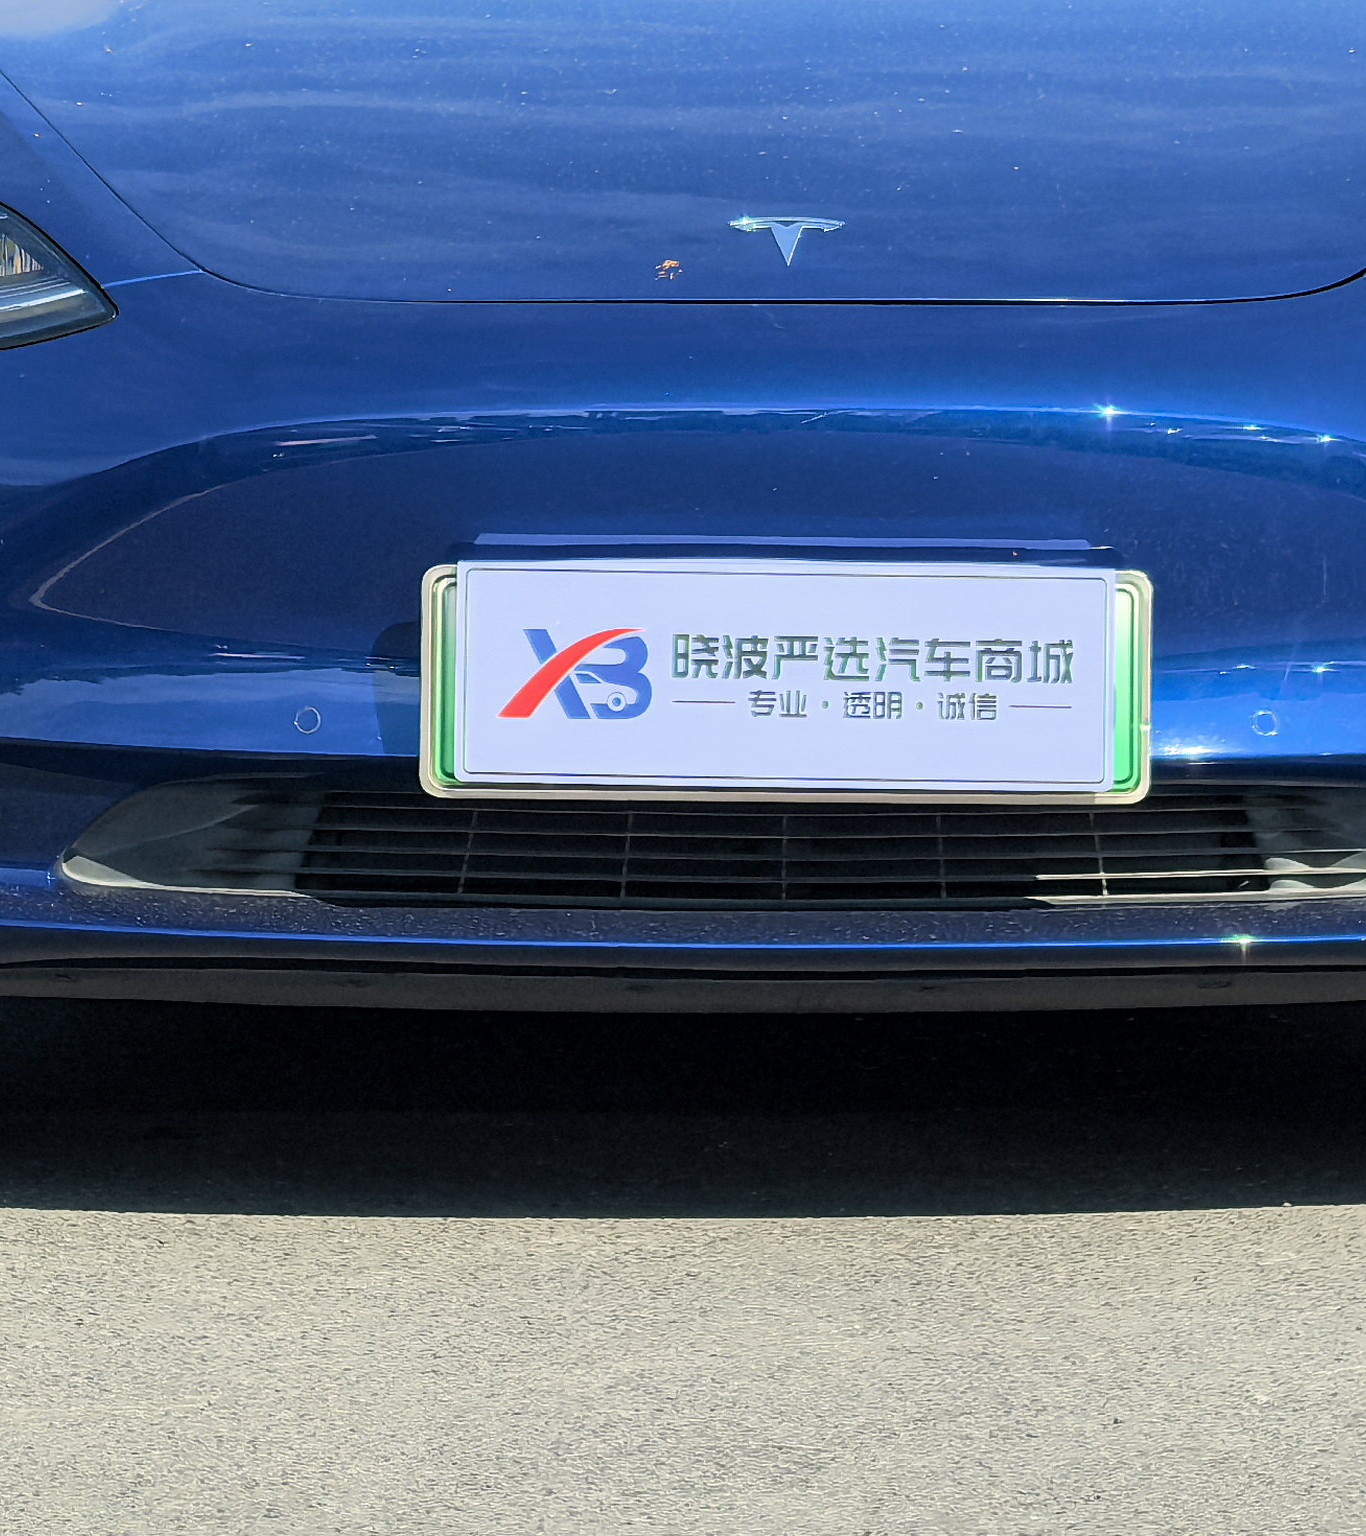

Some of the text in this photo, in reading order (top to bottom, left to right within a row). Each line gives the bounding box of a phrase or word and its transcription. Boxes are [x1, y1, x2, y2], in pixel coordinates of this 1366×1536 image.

[671, 633, 1073, 684] 晓波严选汽车商城
